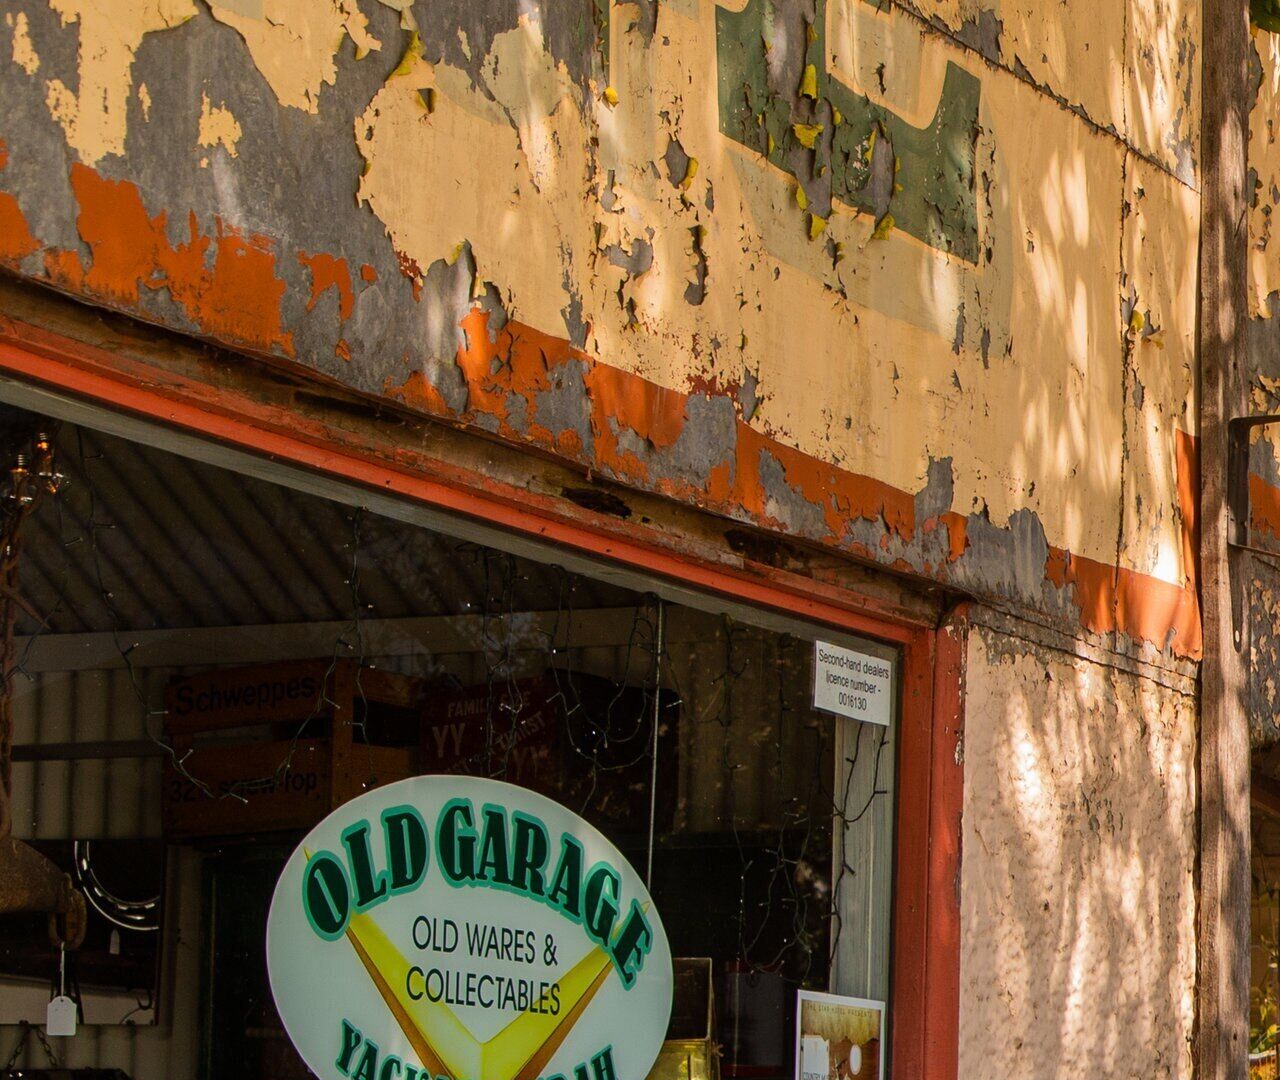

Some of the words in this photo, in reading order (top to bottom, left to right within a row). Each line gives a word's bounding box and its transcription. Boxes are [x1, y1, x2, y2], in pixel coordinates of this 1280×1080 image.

[818, 649, 861, 673] Second-hand
[863, 662, 889, 680] dealers
[826, 670, 849, 688] licence
[850, 679, 877, 694] number
[175, 675, 316, 716] Schweppes
[303, 804, 430, 941] OLD
[435, 798, 652, 990] GARAGE
[411, 915, 459, 953] OLD
[466, 922, 536, 964] WARES
[543, 933, 559, 967] &
[406, 966, 561, 1016] COLLECTABLES
